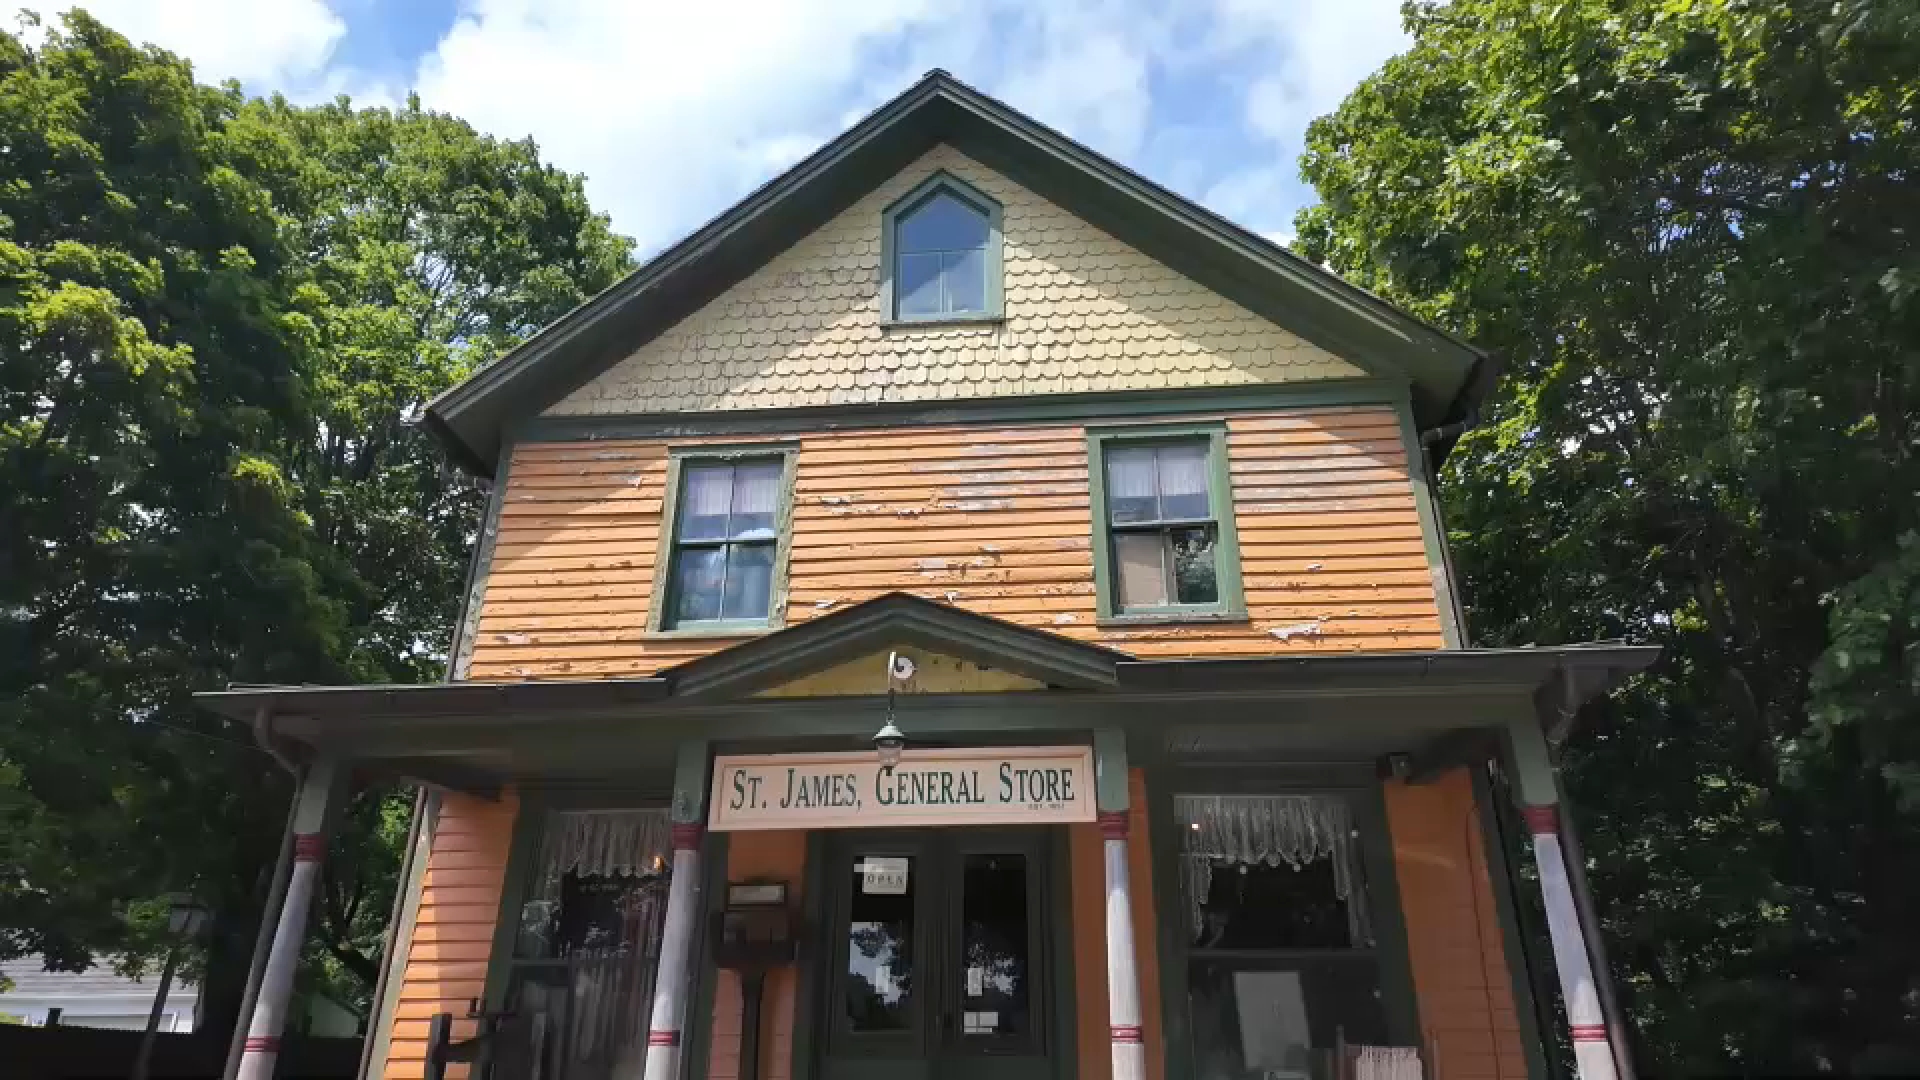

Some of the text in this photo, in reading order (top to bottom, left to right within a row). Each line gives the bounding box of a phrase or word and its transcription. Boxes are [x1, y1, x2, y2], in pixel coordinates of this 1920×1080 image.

[730, 761, 1075, 813] ST. JAMES, GENERAL STORE
